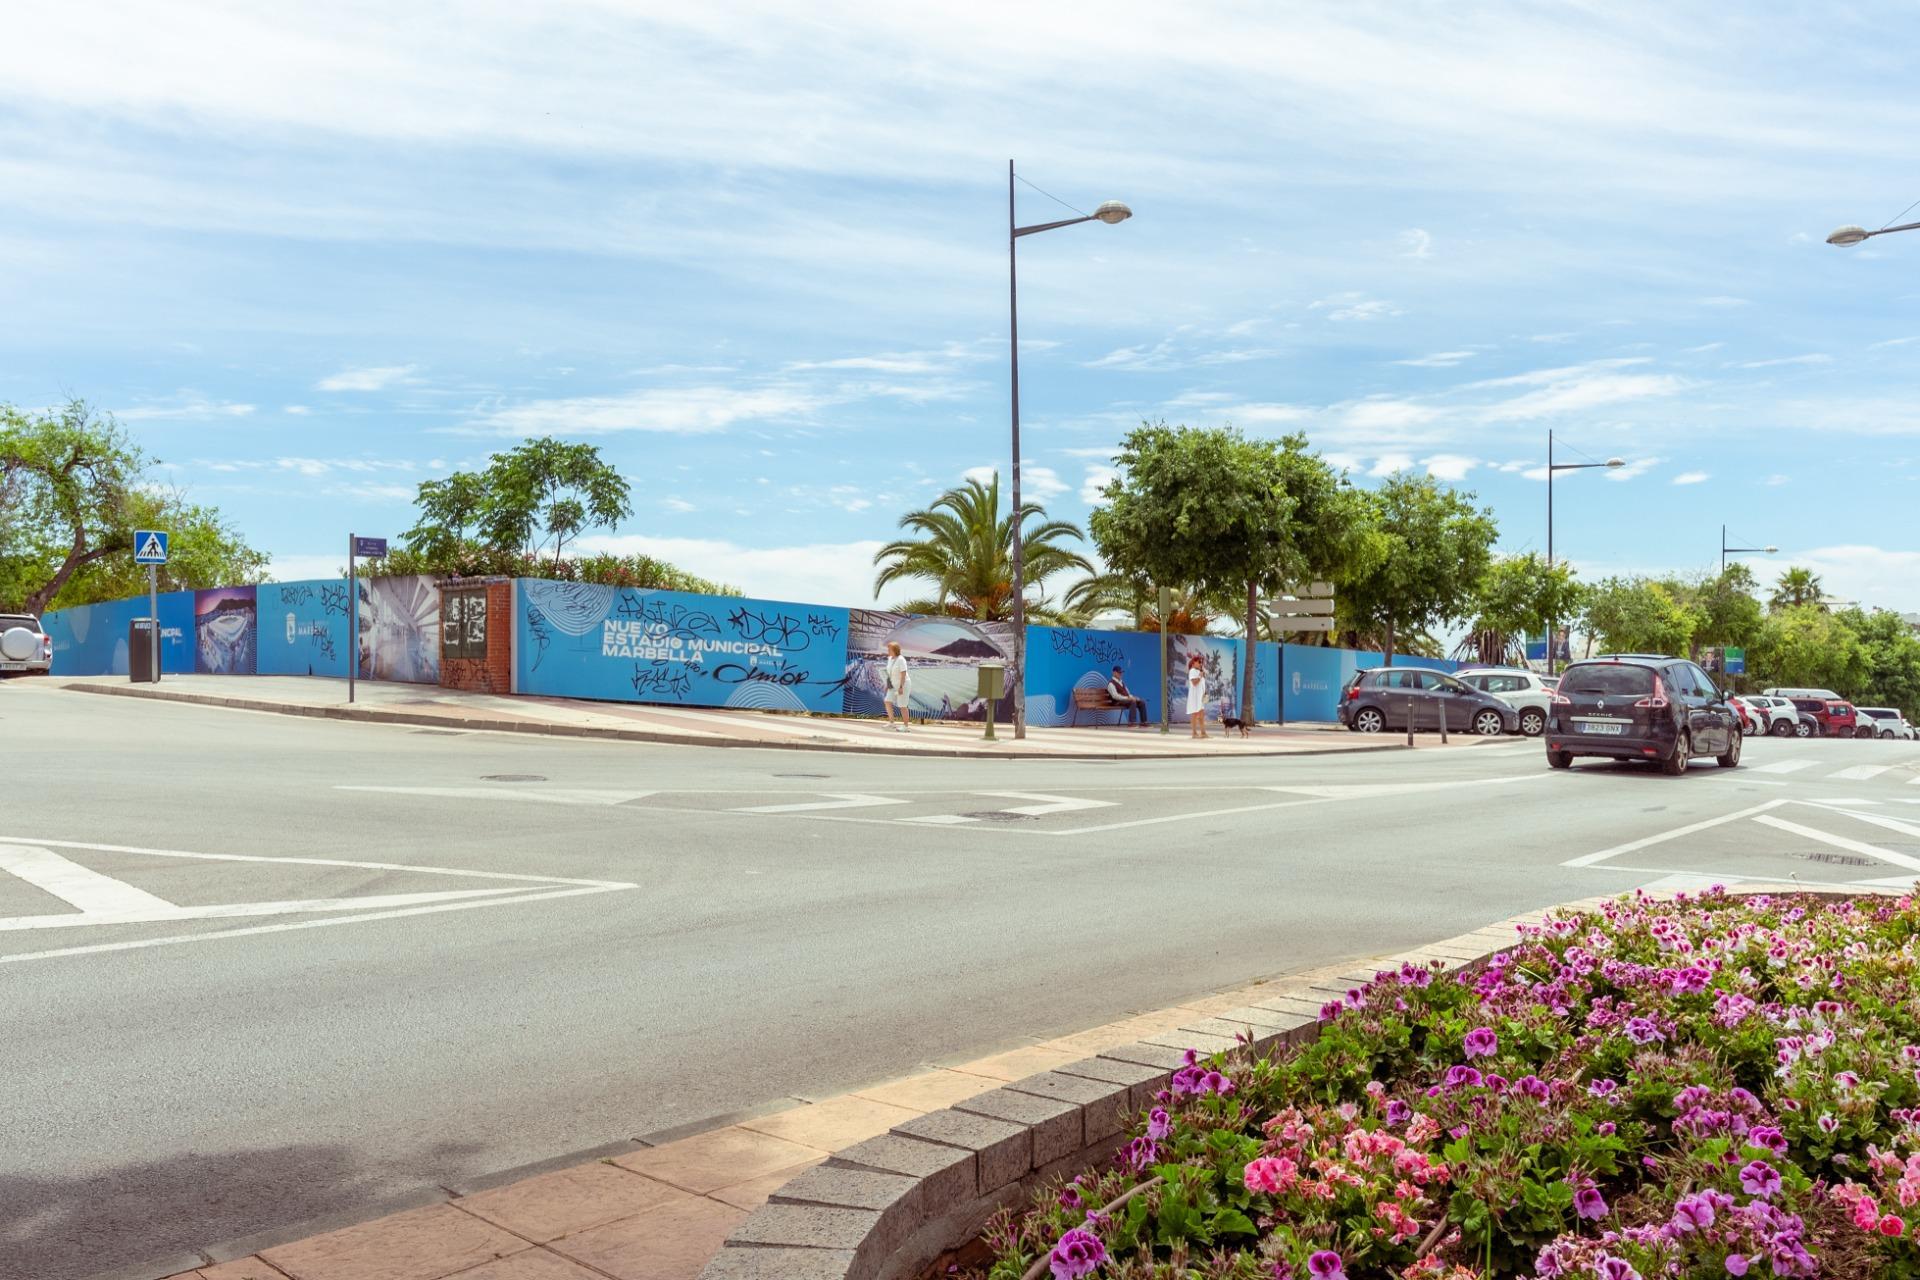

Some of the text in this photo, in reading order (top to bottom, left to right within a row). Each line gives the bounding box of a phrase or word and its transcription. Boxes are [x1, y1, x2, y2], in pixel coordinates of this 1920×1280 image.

[604, 619, 669, 634] NUEVO
[812, 625, 841, 643] CITY
[604, 632, 784, 657] ESTADIO MUNICIPAL
[602, 645, 704, 663] MARBELLA
